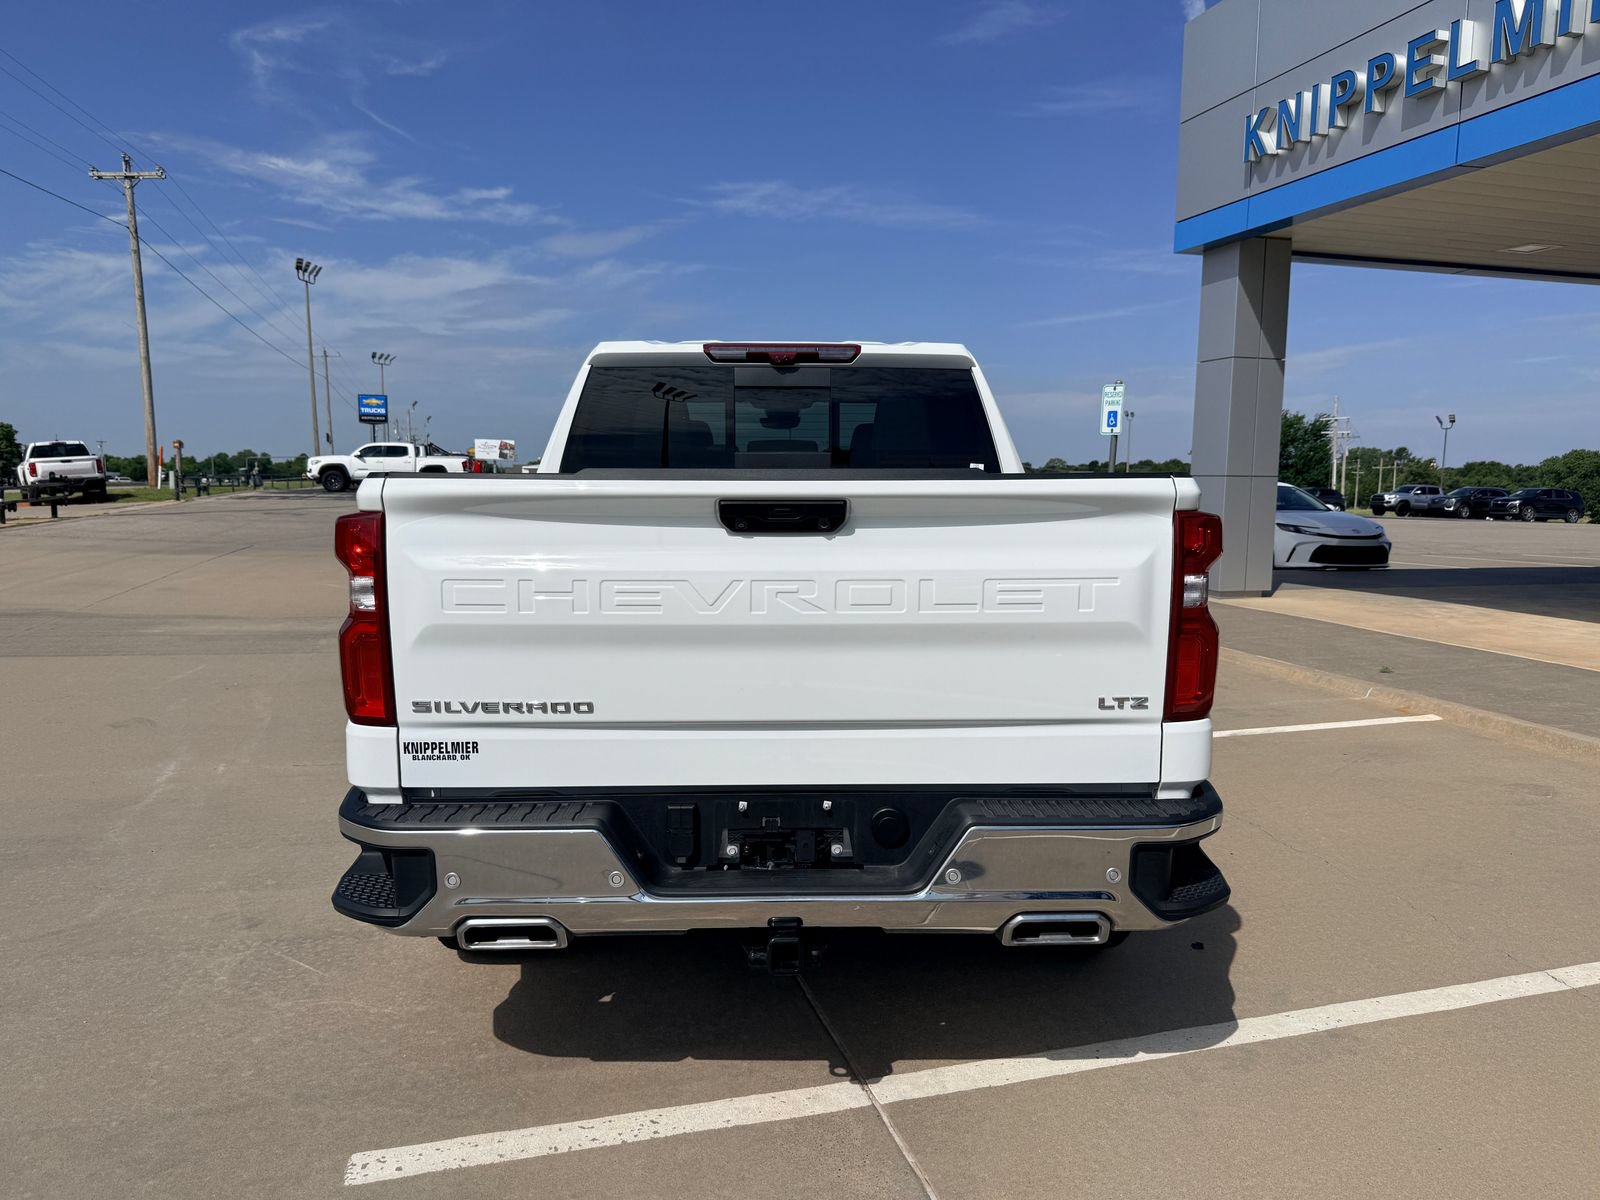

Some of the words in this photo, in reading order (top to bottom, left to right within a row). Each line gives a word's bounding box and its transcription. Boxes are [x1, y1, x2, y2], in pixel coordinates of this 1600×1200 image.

[1243, 0, 1600, 164] KNIPPELMI
[441, 577, 1121, 615] CHEVROLET
[412, 700, 595, 714] SILVERADO
[1098, 696, 1149, 710] LTZ
[403, 741, 479, 755] KNIPPELMIER
[412, 754, 459, 762] BLANCHARD,
